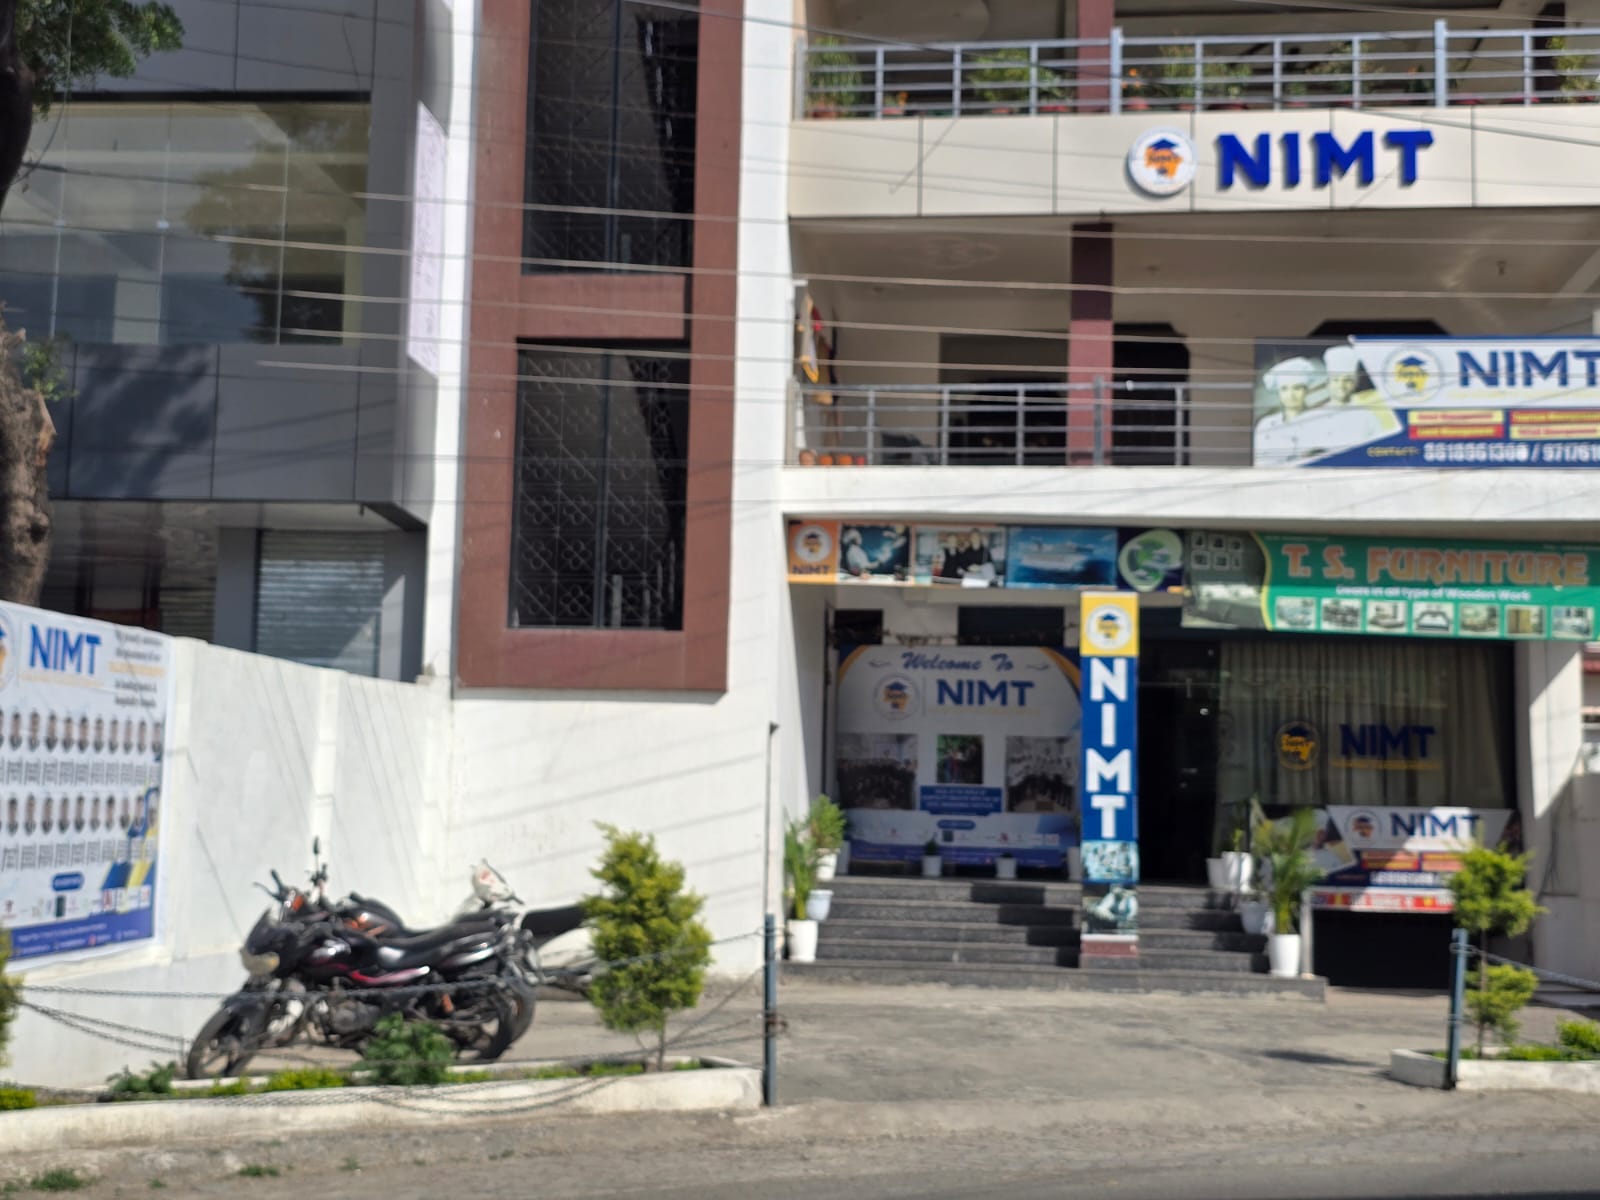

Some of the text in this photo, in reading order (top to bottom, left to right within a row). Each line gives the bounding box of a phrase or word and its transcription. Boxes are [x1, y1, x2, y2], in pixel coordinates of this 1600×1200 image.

[1217, 129, 1434, 188] NIMT
[1457, 350, 1600, 388] NIMT
[1282, 543, 1589, 586] T. S. FURNITURE
[29, 623, 101, 676] NIMT
[901, 651, 1014, 672] Welcome To
[936, 678, 1034, 707] NIMT
[1085, 656, 1132, 839] NIMT
[1339, 723, 1435, 759] NIMT
[1389, 811, 1480, 838] NIMT
